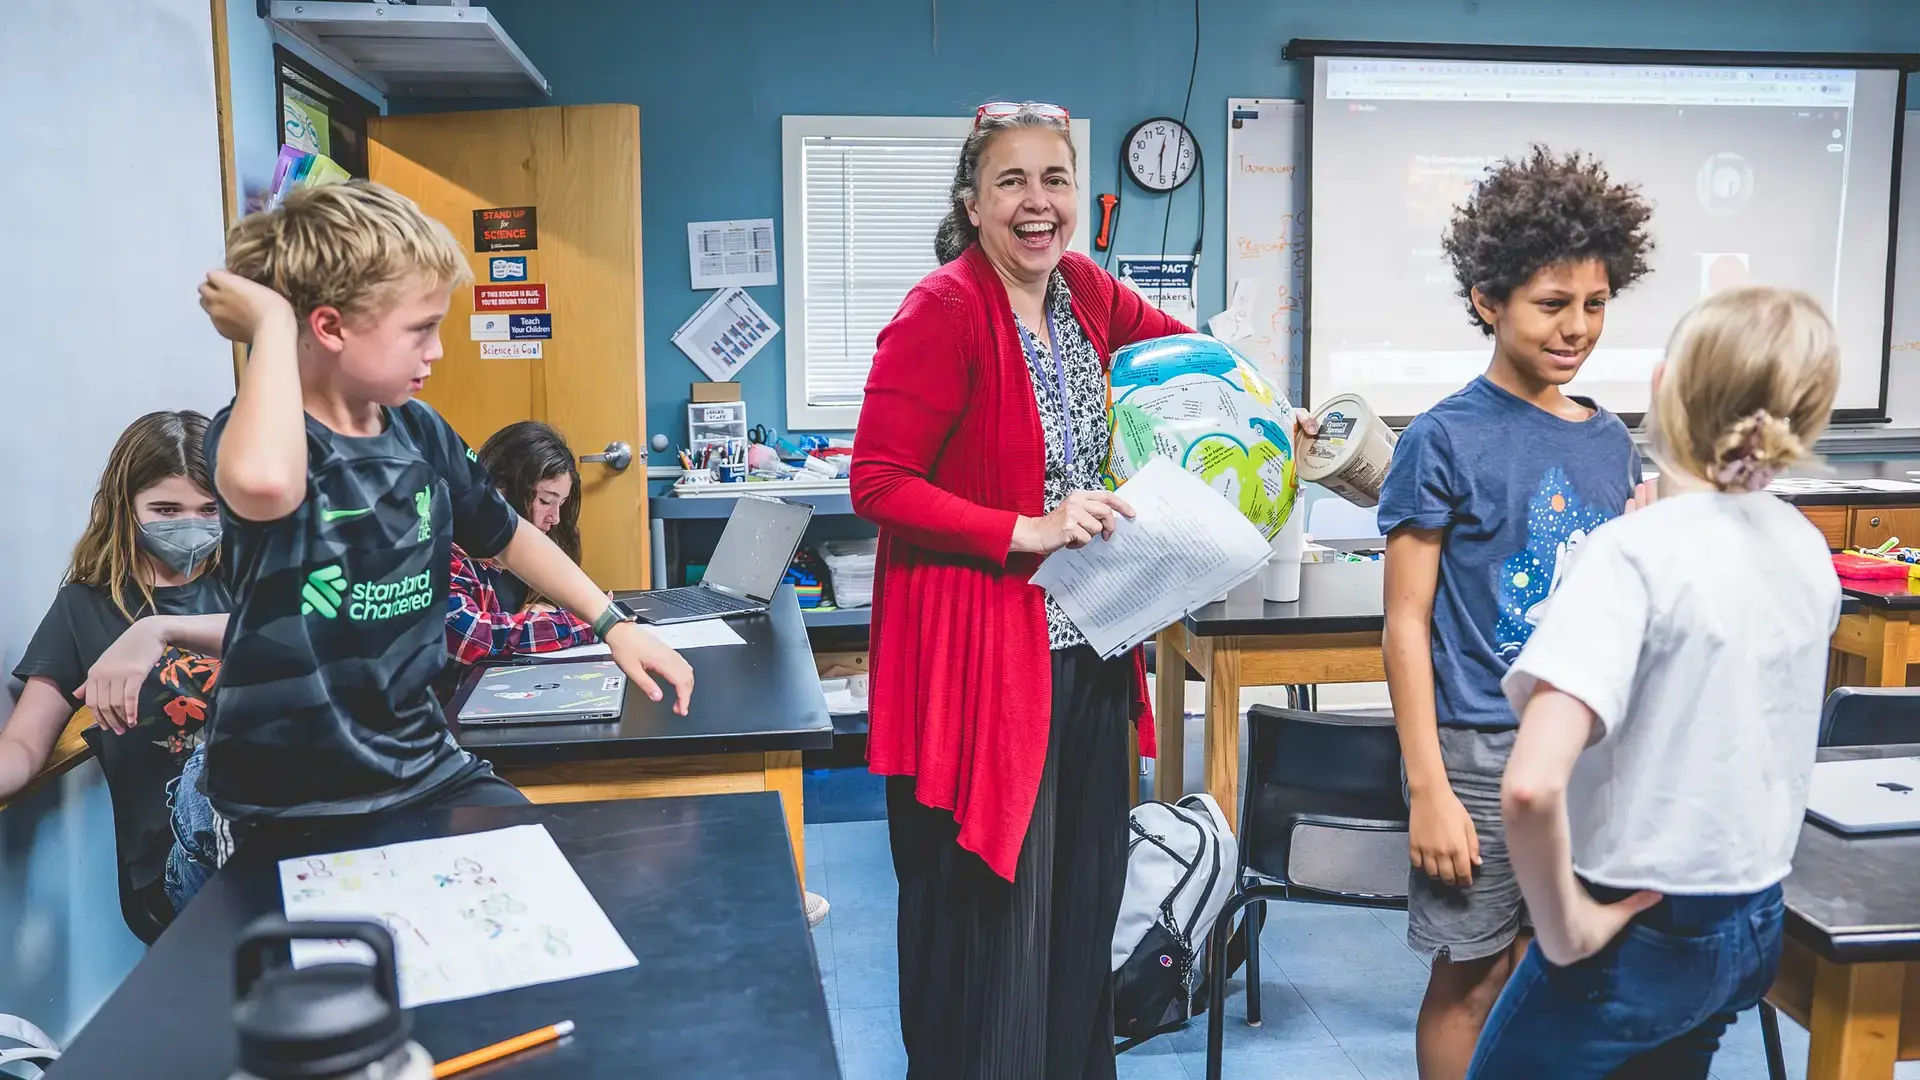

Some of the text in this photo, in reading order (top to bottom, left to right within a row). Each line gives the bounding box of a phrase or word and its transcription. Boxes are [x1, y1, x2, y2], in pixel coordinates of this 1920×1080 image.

[1144, 130, 1152, 139] 11
[1155, 126, 1165, 135] 12
[1170, 128, 1175, 138] 1
[1136, 140, 1146, 150] 10
[1132, 152, 1139, 162] 9
[1183, 149, 1190, 158] 3
[1138, 164, 1144, 174] 8
[1180, 162, 1186, 170] 4
[1148, 172, 1154, 181] 7
[1160, 175, 1166, 184] 6
[483, 210, 525, 220] STAND UP
[500, 220, 509, 229] for
[484, 229, 526, 240] SCIENCE
[520, 317, 540, 325] Teach
[483, 343, 539, 355] Science is Cool
[417, 527, 431, 542] LFC
[352, 569, 430, 601] standard
[349, 587, 433, 620] chartered
